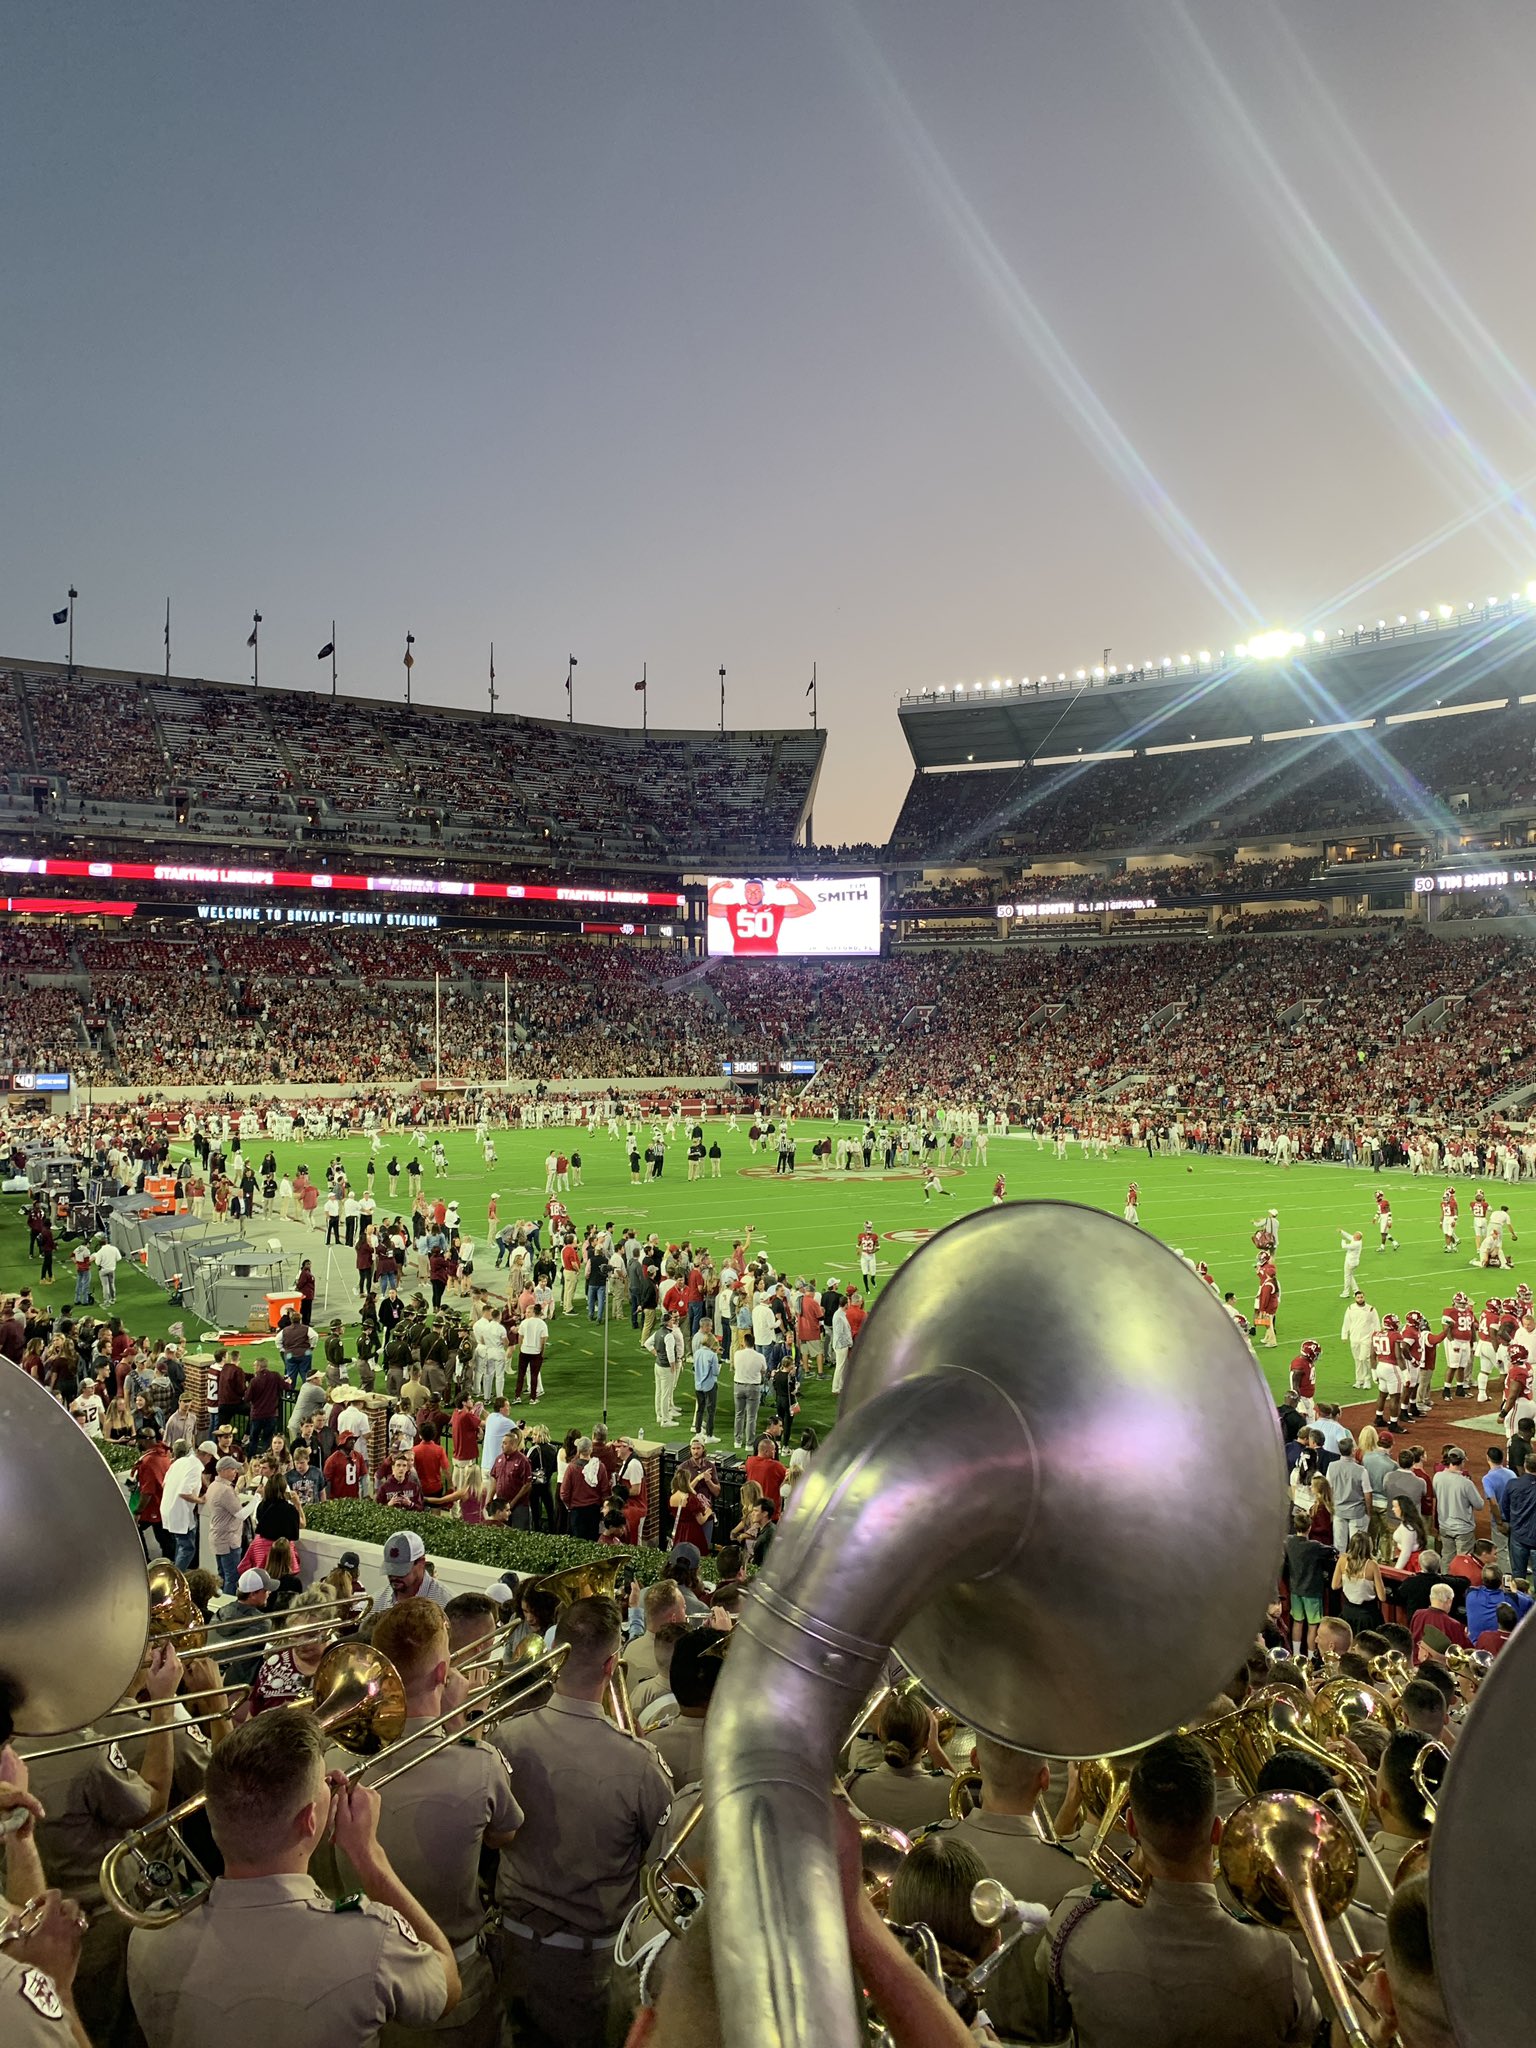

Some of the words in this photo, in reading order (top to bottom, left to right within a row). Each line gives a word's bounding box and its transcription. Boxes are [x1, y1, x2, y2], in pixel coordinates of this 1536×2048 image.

[1415, 877, 1434, 892] 50
[1438, 876, 1462, 889] TIM
[1464, 872, 1508, 888] SMITH
[818, 890, 868, 903] SMITH
[997, 905, 1014, 917] 50
[1016, 904, 1037, 916] TIM
[1038, 903, 1074, 915] SMITH
[1110, 900, 1145, 911] GIFFORD,
[1146, 899, 1157, 908] FL
[197, 906, 260, 920] WELCOME
[266, 909, 281, 921] TO
[287, 909, 381, 925] BRYANT-DENNY
[386, 913, 437, 927] STADIUM
[736, 911, 774, 938] 50
[734, 1062, 758, 1073] 30:06
[781, 1062, 792, 1072] 40
[16, 1075, 34, 1087] 40
[550, 1205, 559, 1216] 18
[1474, 1206, 1484, 1216] 21
[862, 1239, 874, 1251] 23
[1372, 1336, 1391, 1355] 50
[83, 1407, 97, 1424] 12
[346, 1463, 356, 1485] 8
